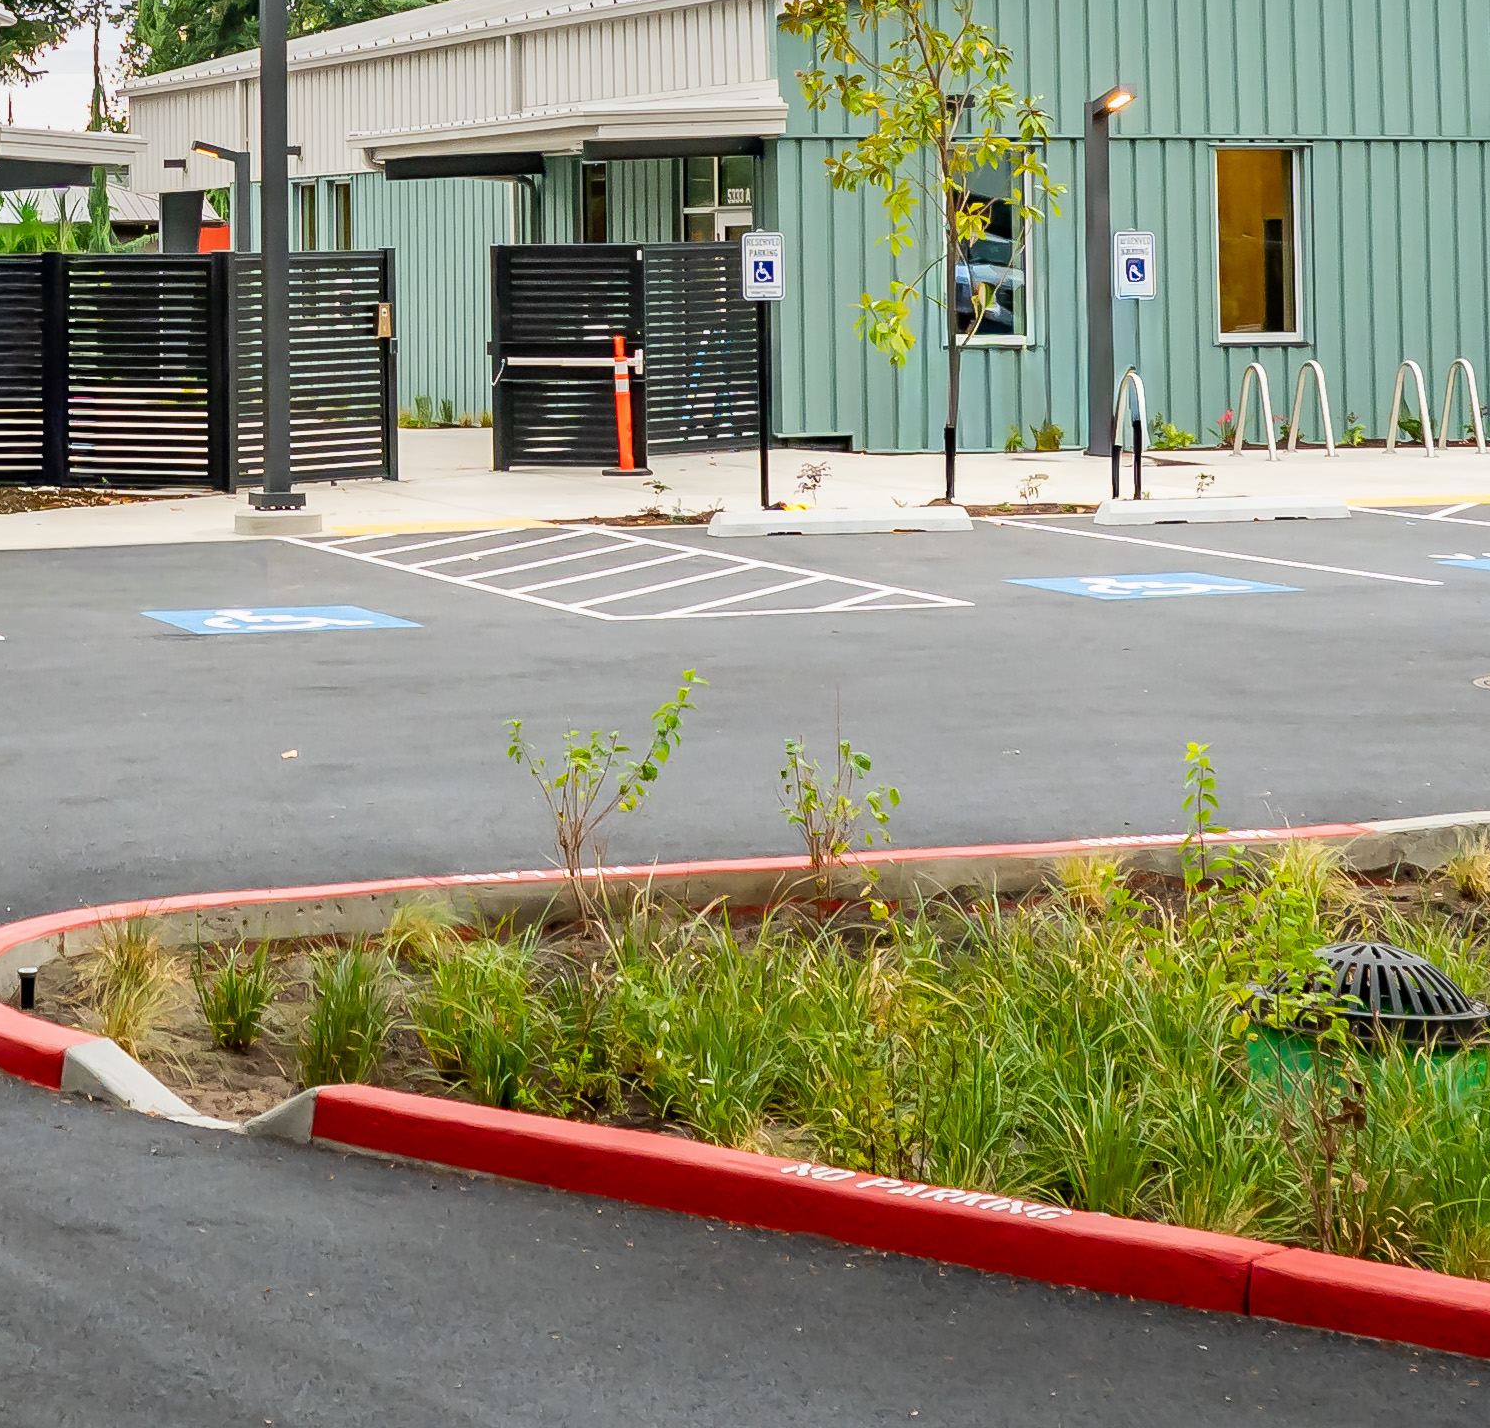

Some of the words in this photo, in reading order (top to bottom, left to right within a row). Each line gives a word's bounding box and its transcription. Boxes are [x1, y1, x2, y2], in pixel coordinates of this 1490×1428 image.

[745, 187, 751, 203] A
[746, 237, 780, 246] RESERVED
[749, 249, 778, 257] PARKING
[780, 1163, 856, 1182] NO
[855, 1176, 1072, 1221] PARKING
